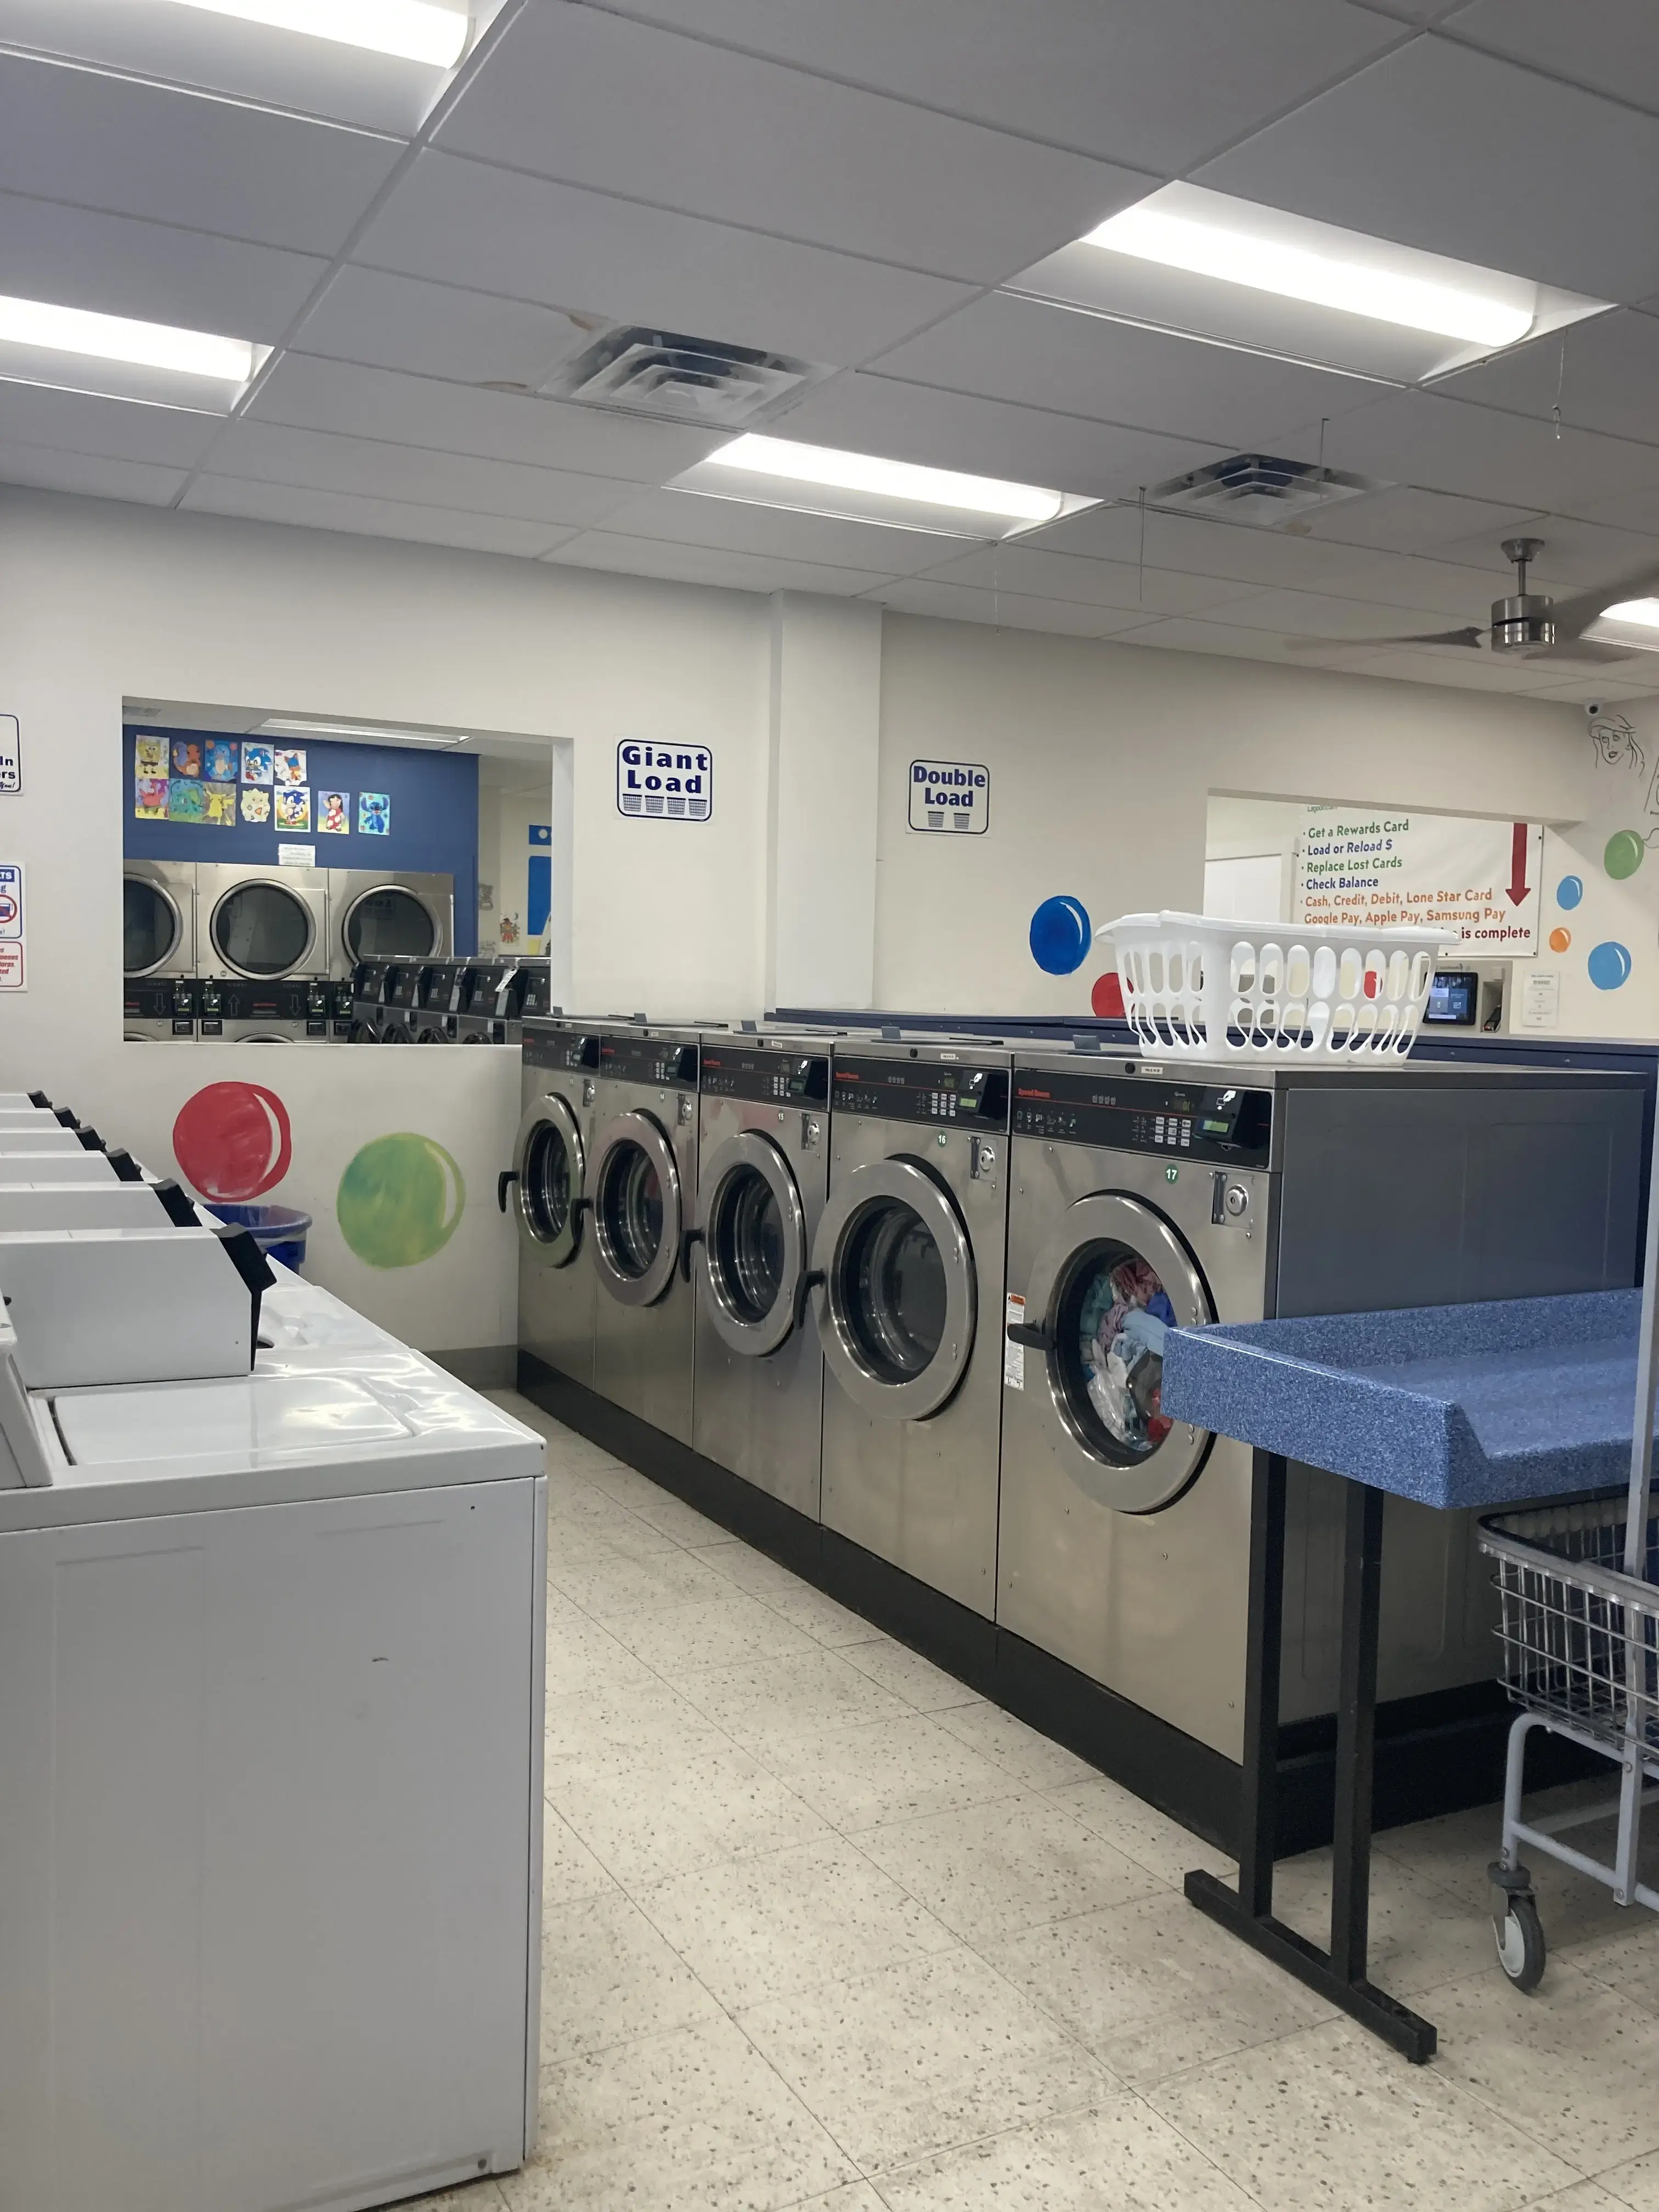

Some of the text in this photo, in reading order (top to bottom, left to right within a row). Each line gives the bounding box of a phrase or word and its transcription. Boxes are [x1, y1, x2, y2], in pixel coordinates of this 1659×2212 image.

[622, 746, 708, 771] Giant
[628, 769, 701, 793] Load
[913, 765, 986, 787] Double
[925, 787, 973, 807] Load
[1308, 827, 1325, 838] Get
[1336, 822, 1380, 836] Rewards
[1384, 819, 1409, 832] Card
[1308, 843, 1330, 855] Load
[1333, 845, 1344, 854] or
[1347, 839, 1383, 853] Reload
[1307, 856, 1402, 875] Replace Lost Cards
[1306, 876, 1379, 890] Check Balance
[1306, 888, 1492, 908] Cash, Credit, Debit, Lone Star Card
[1305, 907, 1506, 926] Google Pay, Apple Pay, Samsung Pay
[1462, 927, 1471, 939] is
[1475, 926, 1531, 941] complete
[778, 1113, 784, 1121] 15
[938, 1135, 946, 1144] 16
[1166, 1169, 1177, 1180] 17
